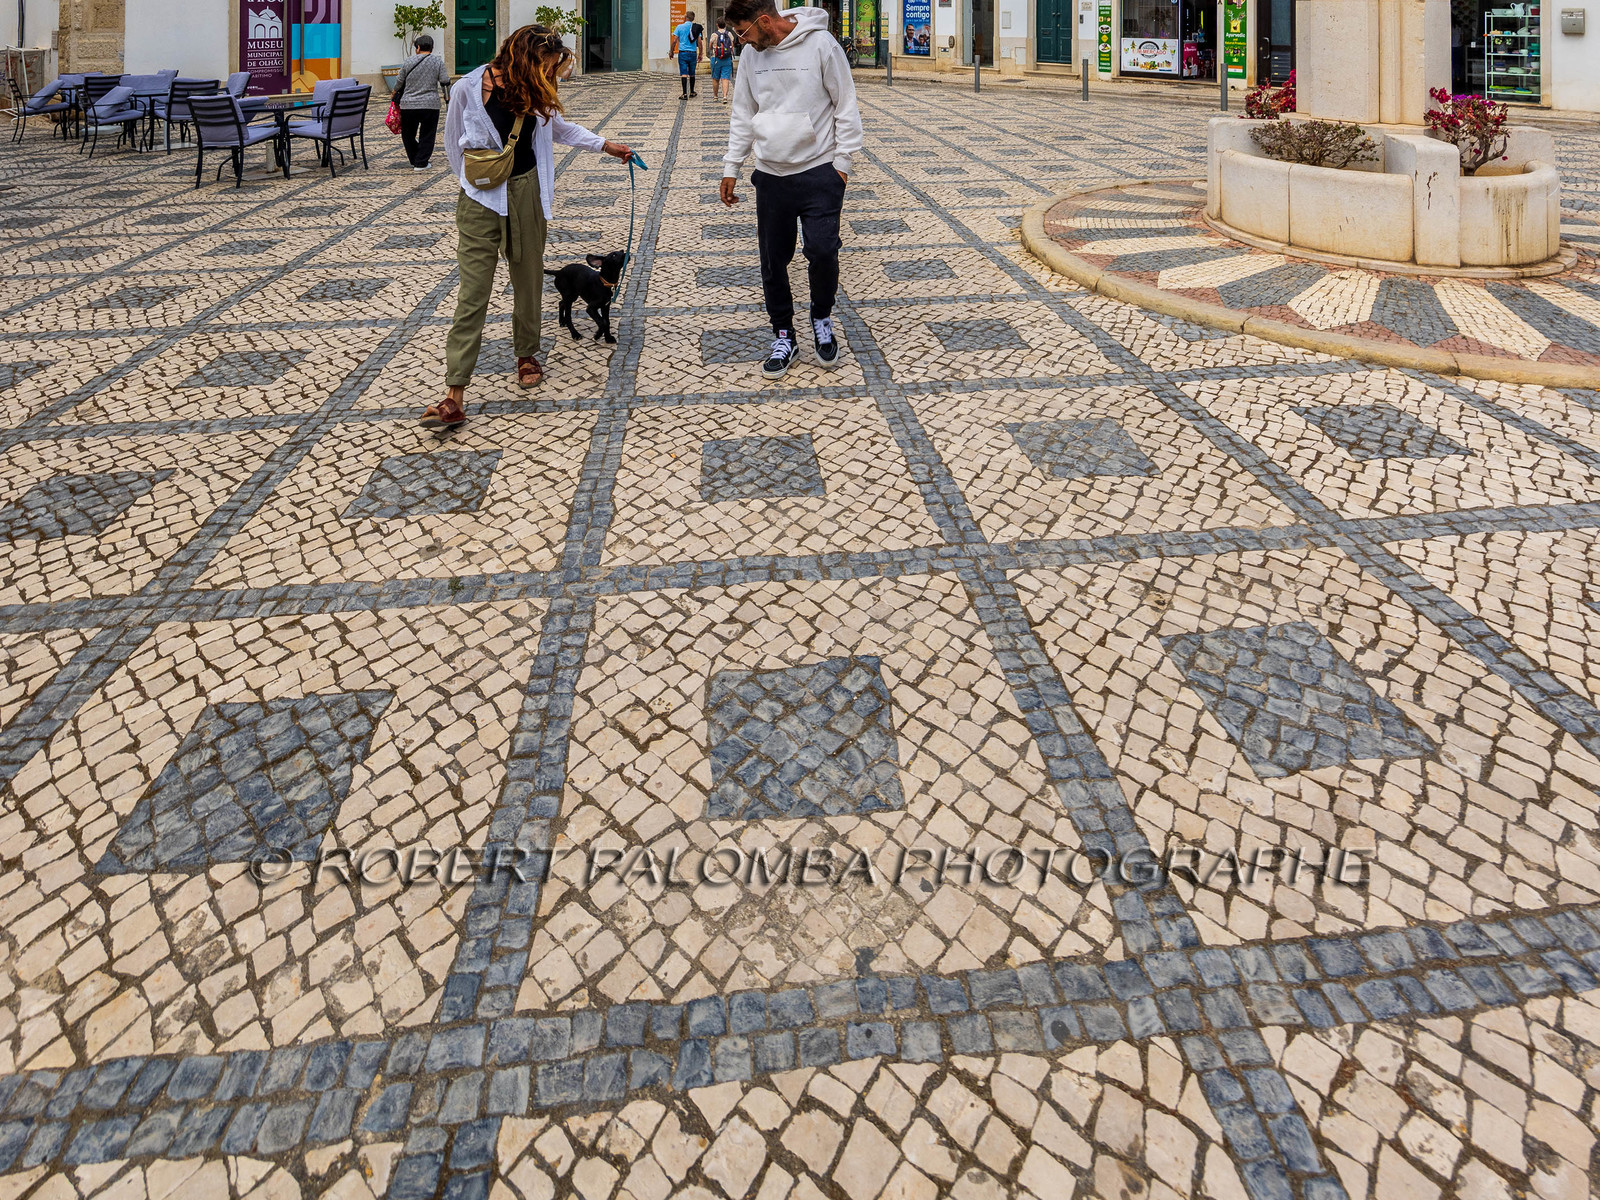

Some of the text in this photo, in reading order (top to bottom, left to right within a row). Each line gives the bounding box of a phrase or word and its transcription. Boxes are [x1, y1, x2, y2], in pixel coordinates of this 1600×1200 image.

[906, 3, 930, 12] Sempre
[906, 12, 930, 20] contigo
[247, 40, 284, 49] MUSEU
[258, 59, 284, 67] OLHÃO
